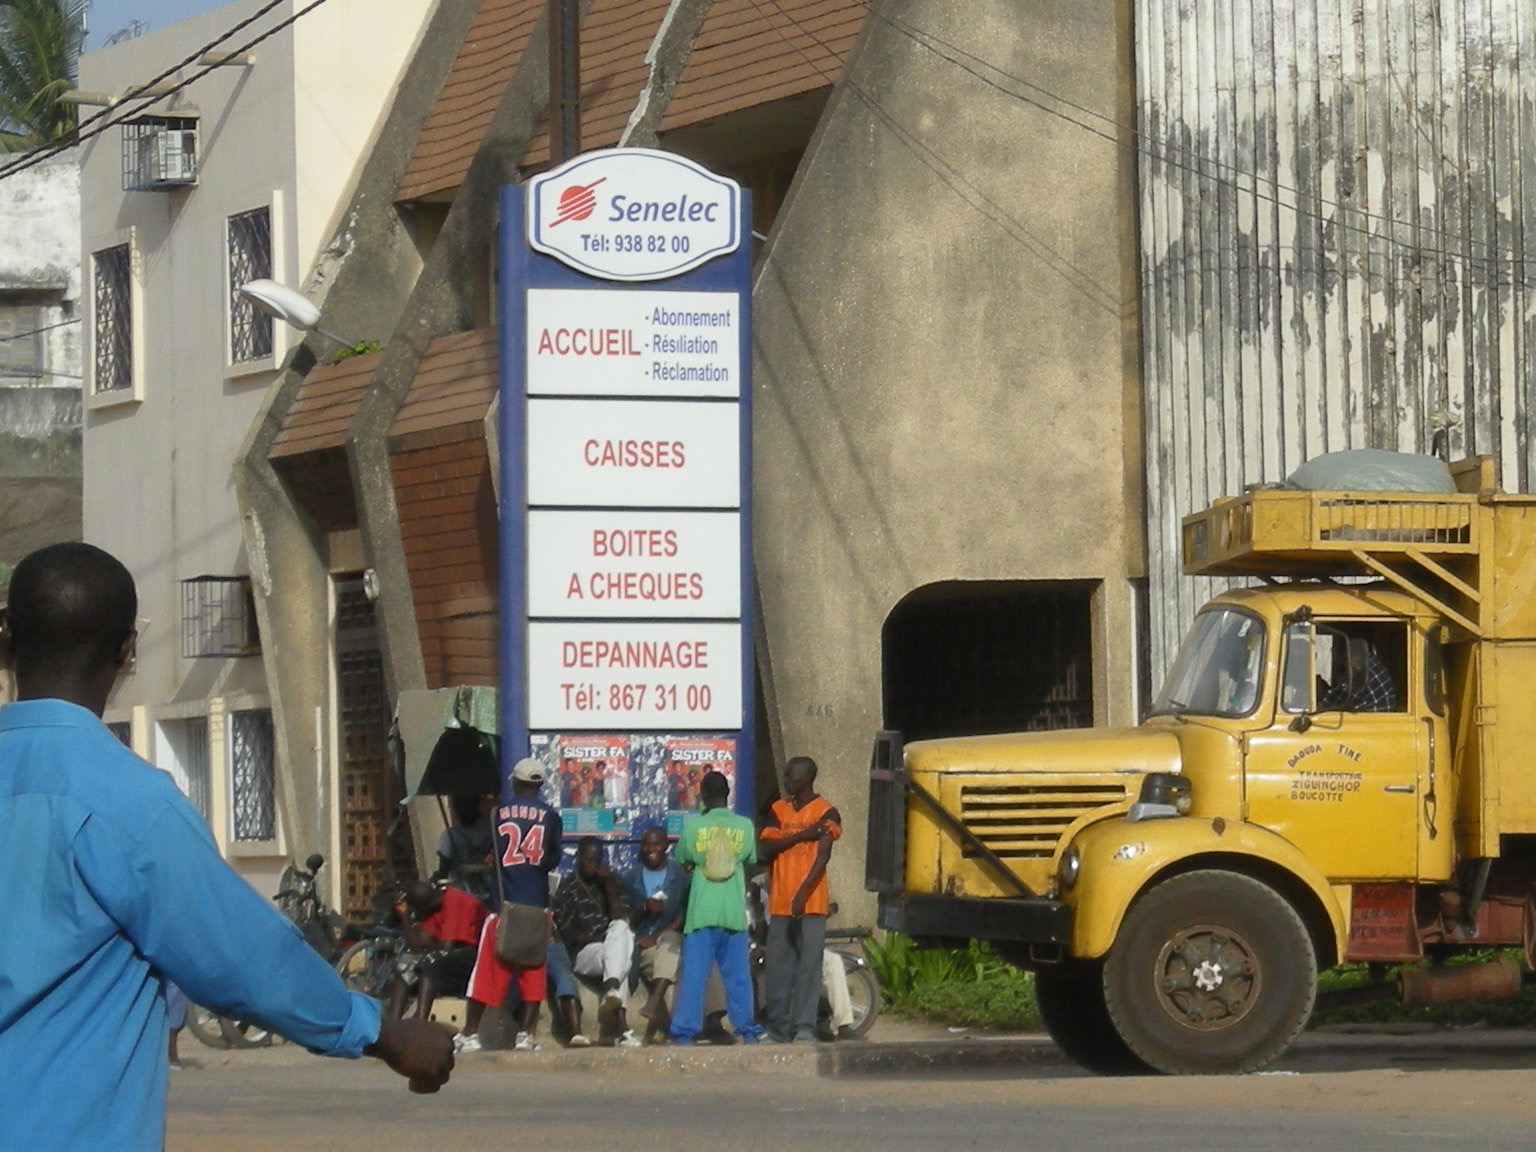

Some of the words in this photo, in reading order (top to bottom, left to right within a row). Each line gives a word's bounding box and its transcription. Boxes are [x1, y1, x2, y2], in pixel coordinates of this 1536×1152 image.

[608, 195, 718, 223] Senelec
[580, 234, 610, 253] Tél:
[614, 235, 642, 253] 938
[647, 235, 666, 253] 82
[671, 236, 690, 253] 00
[651, 307, 731, 328] Abonnement
[537, 328, 641, 356] ACCUEIL
[652, 334, 718, 355] Résiliation
[652, 361, 729, 382] Réclamation
[583, 439, 686, 468] CAISSES
[592, 530, 678, 557] BOITES
[566, 572, 584, 599] A
[589, 572, 704, 601] CHEQUES
[562, 641, 709, 669] DEPANNAGE
[560, 682, 601, 711] Tél:
[609, 684, 647, 711] 867
[654, 684, 677, 711] 31
[686, 684, 712, 711] 00
[563, 747, 608, 758] SISTER
[610, 746, 625, 758] FA
[671, 749, 714, 760] SISTER
[717, 749, 733, 760] FA
[497, 821, 546, 868] 24
